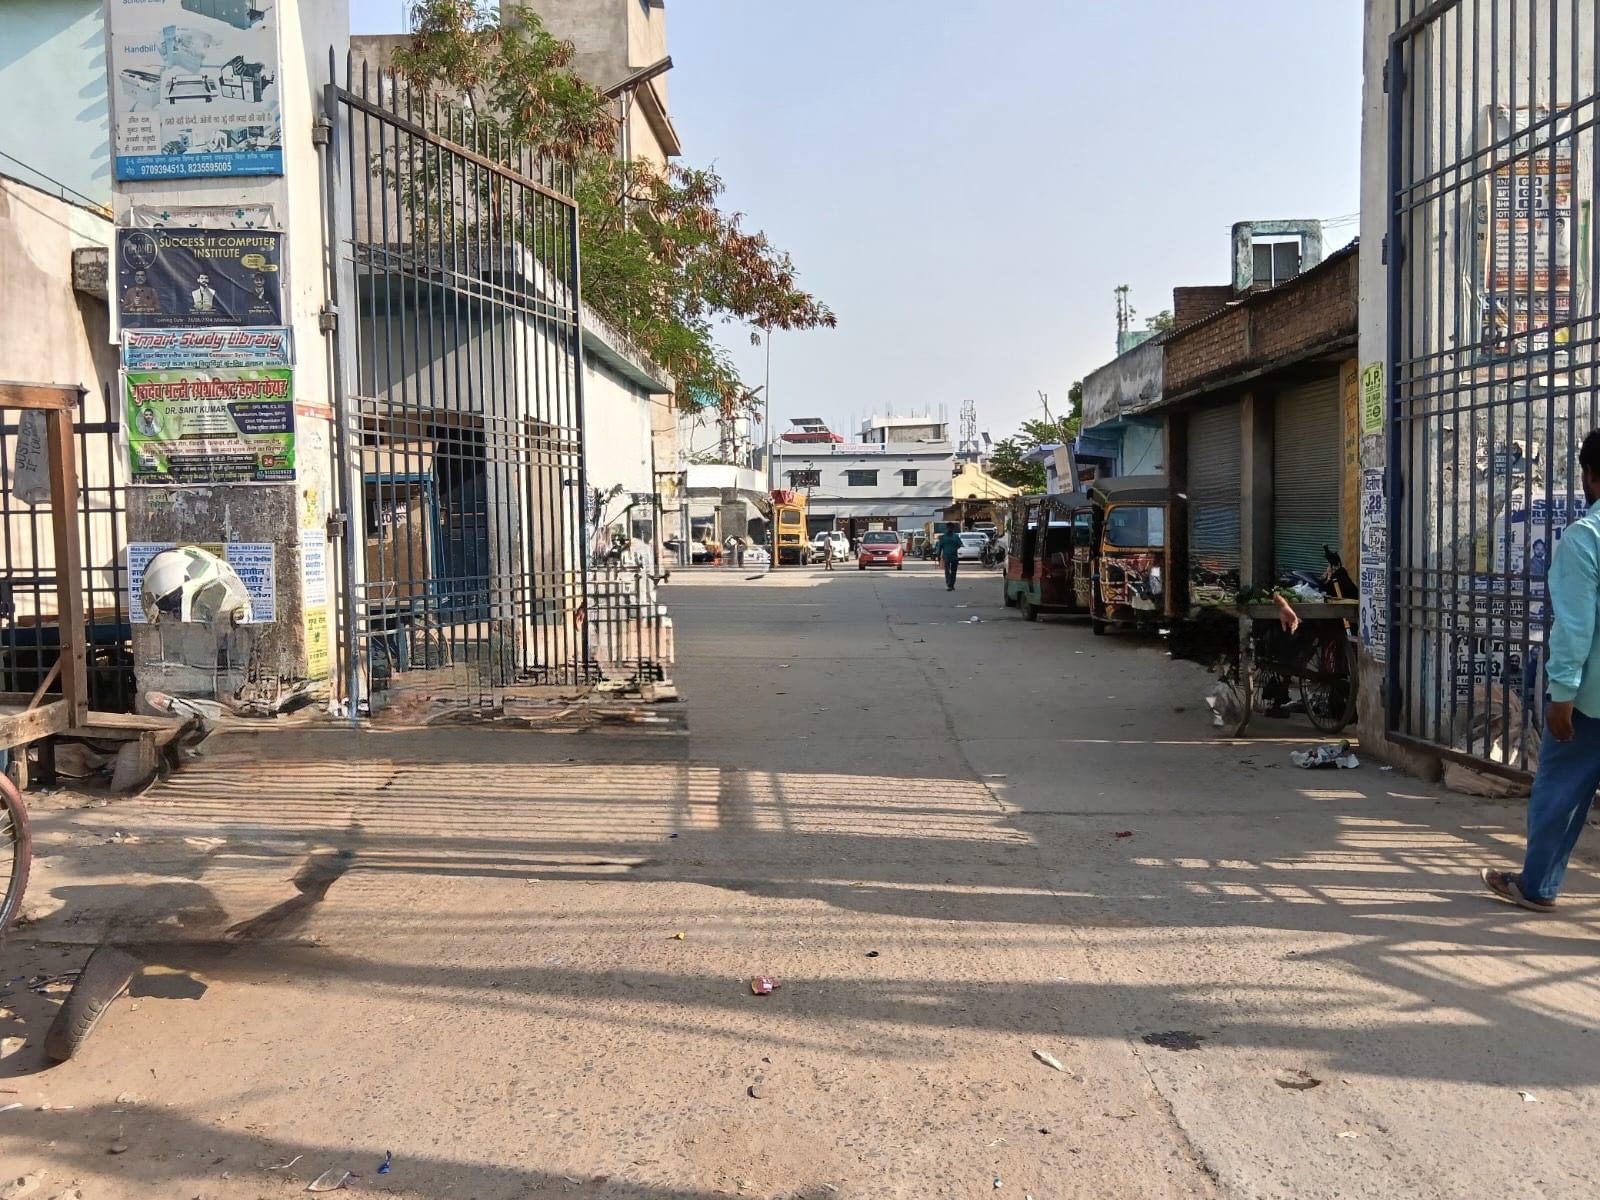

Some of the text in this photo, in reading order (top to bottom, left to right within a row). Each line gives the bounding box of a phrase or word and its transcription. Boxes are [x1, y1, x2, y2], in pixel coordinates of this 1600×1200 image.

[124, 43, 156, 53] Handbill
[141, 164, 186, 175] 9709394513,
[188, 162, 232, 174] 8235595005
[159, 237, 275, 248] SUCCESS IT COMPUTER
[194, 248, 240, 258] INSTITUTE
[180, 331, 224, 351] Study
[228, 331, 283, 350] Library
[1365, 370, 1381, 387] J.P.
[165, 407, 177, 415] DR.
[179, 406, 198, 414] SANT
[199, 405, 226, 414] KUMAR
[25, 458, 38, 473] IF
[1369, 494, 1382, 510] 28
[1498, 643, 1522, 651] ARIL
